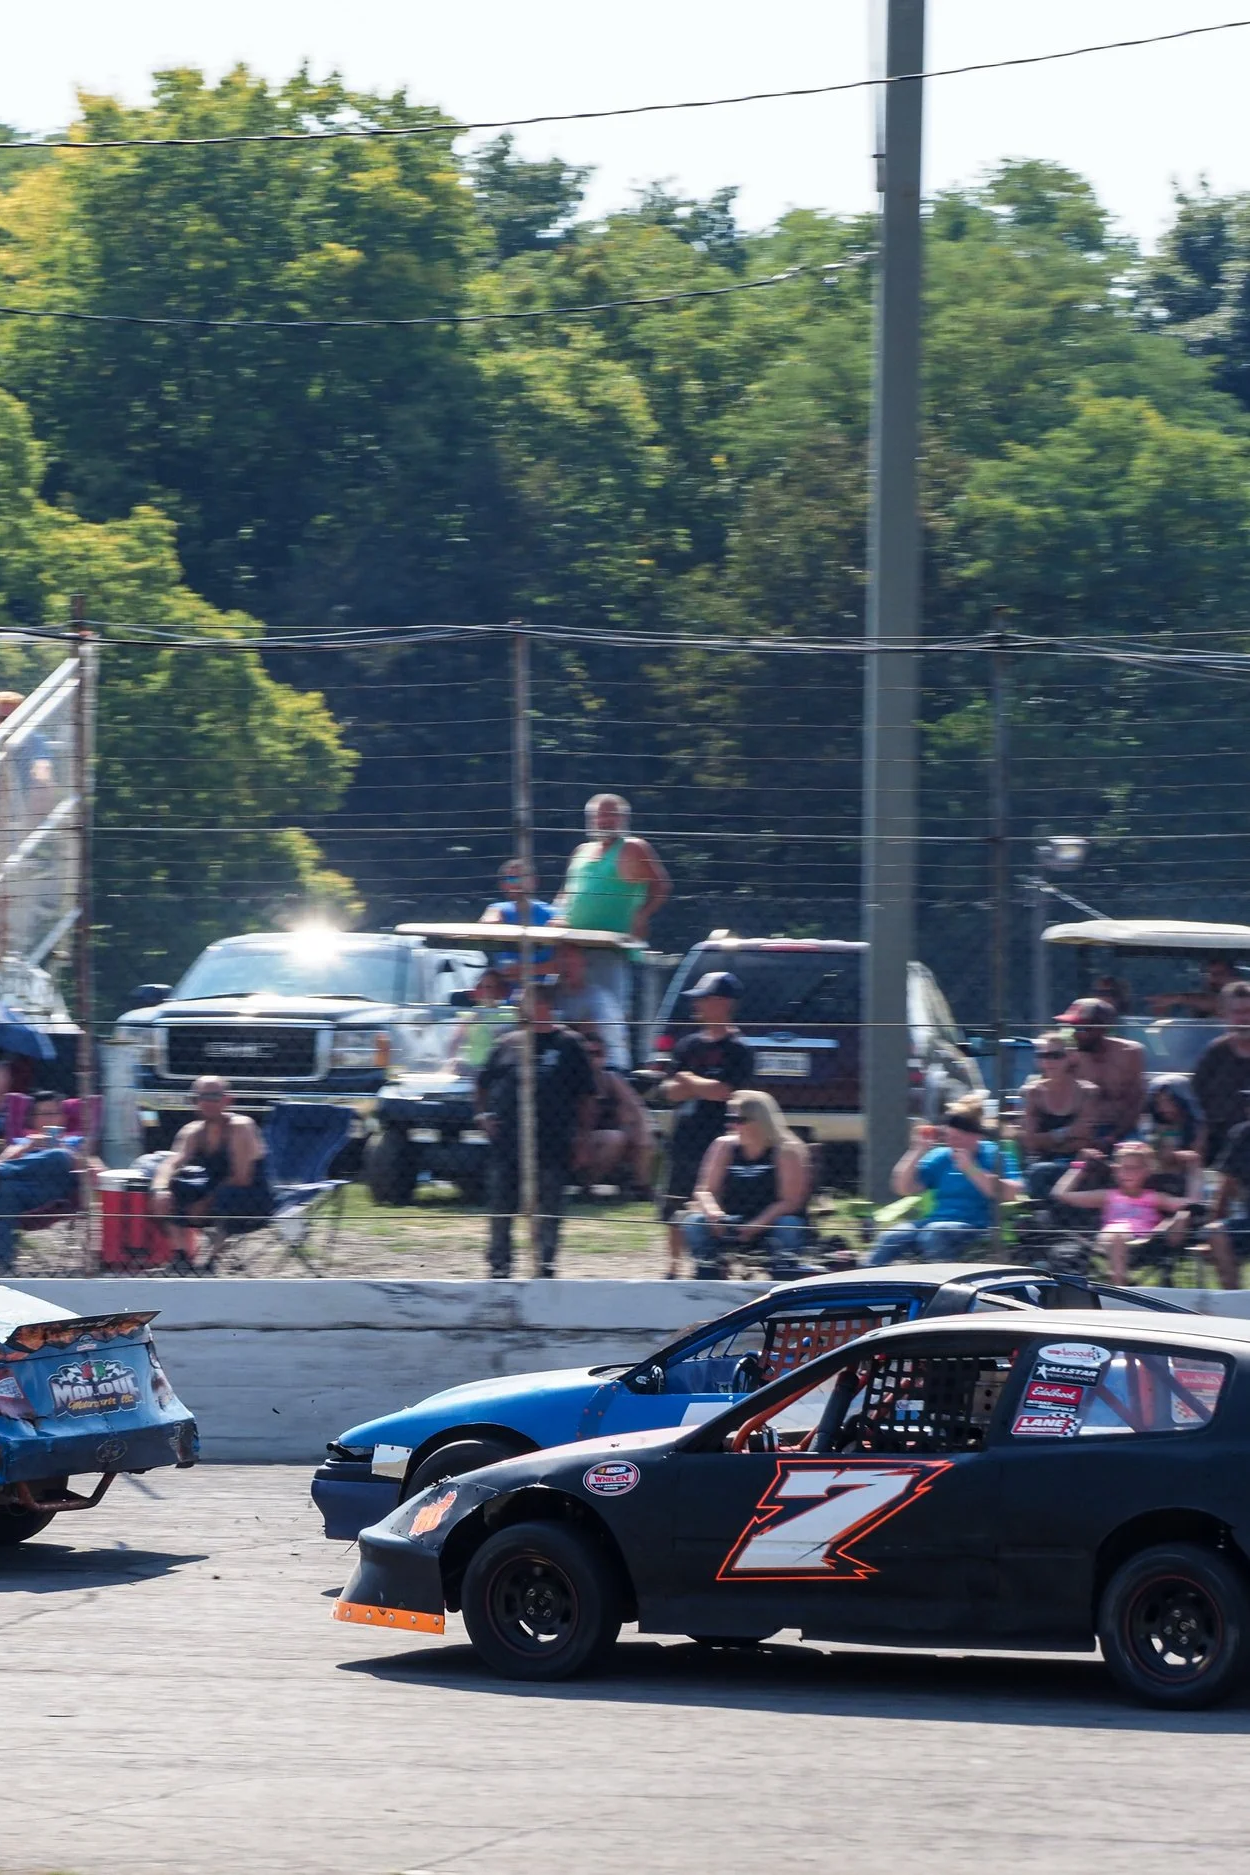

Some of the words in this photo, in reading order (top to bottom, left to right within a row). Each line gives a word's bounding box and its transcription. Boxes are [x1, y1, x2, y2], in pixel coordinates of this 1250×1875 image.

[1046, 1366, 1098, 1377] ALLSTAR
[1031, 1386, 1078, 1400] Edelbrock
[1020, 1418, 1068, 1427] LANE
[731, 1467, 920, 1571] 7
